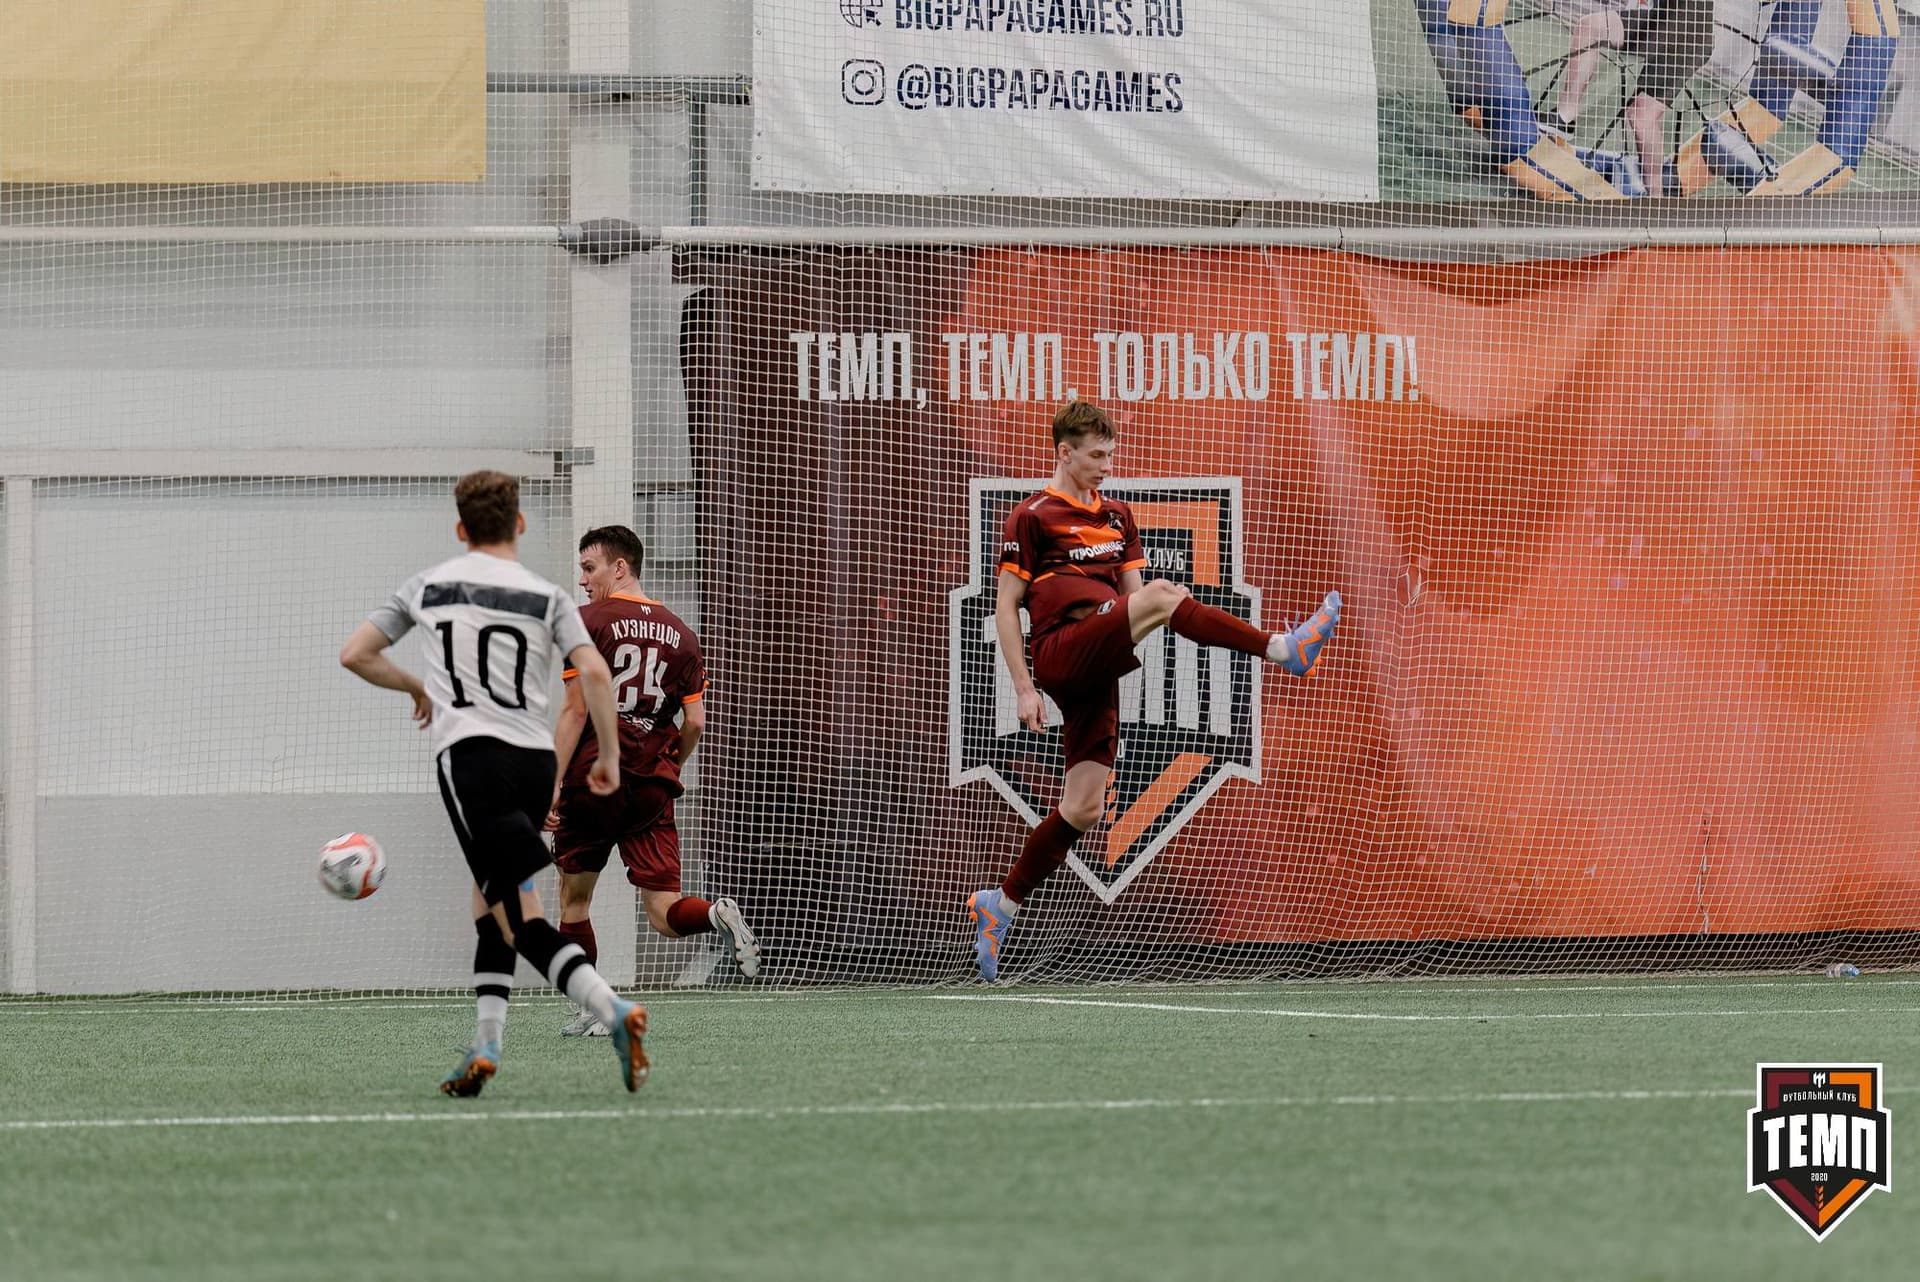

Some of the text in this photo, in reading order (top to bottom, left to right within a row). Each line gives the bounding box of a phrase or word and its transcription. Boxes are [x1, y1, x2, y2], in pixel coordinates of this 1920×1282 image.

[895, 0, 1184, 37] BIGPAPAGAMES.RU
[897, 63, 1183, 113] @BIGPAPAGAMES
[789, 332, 927, 409] ТЕМП,
[1093, 332, 1270, 401] ТОЛЬКО
[1286, 333, 1418, 400] ТЕМП!
[1142, 546, 1185, 571] КЛУБ
[611, 618, 681, 649] КУЗНЕЦОВ
[436, 619, 528, 710] 10
[612, 643, 666, 714] 24
